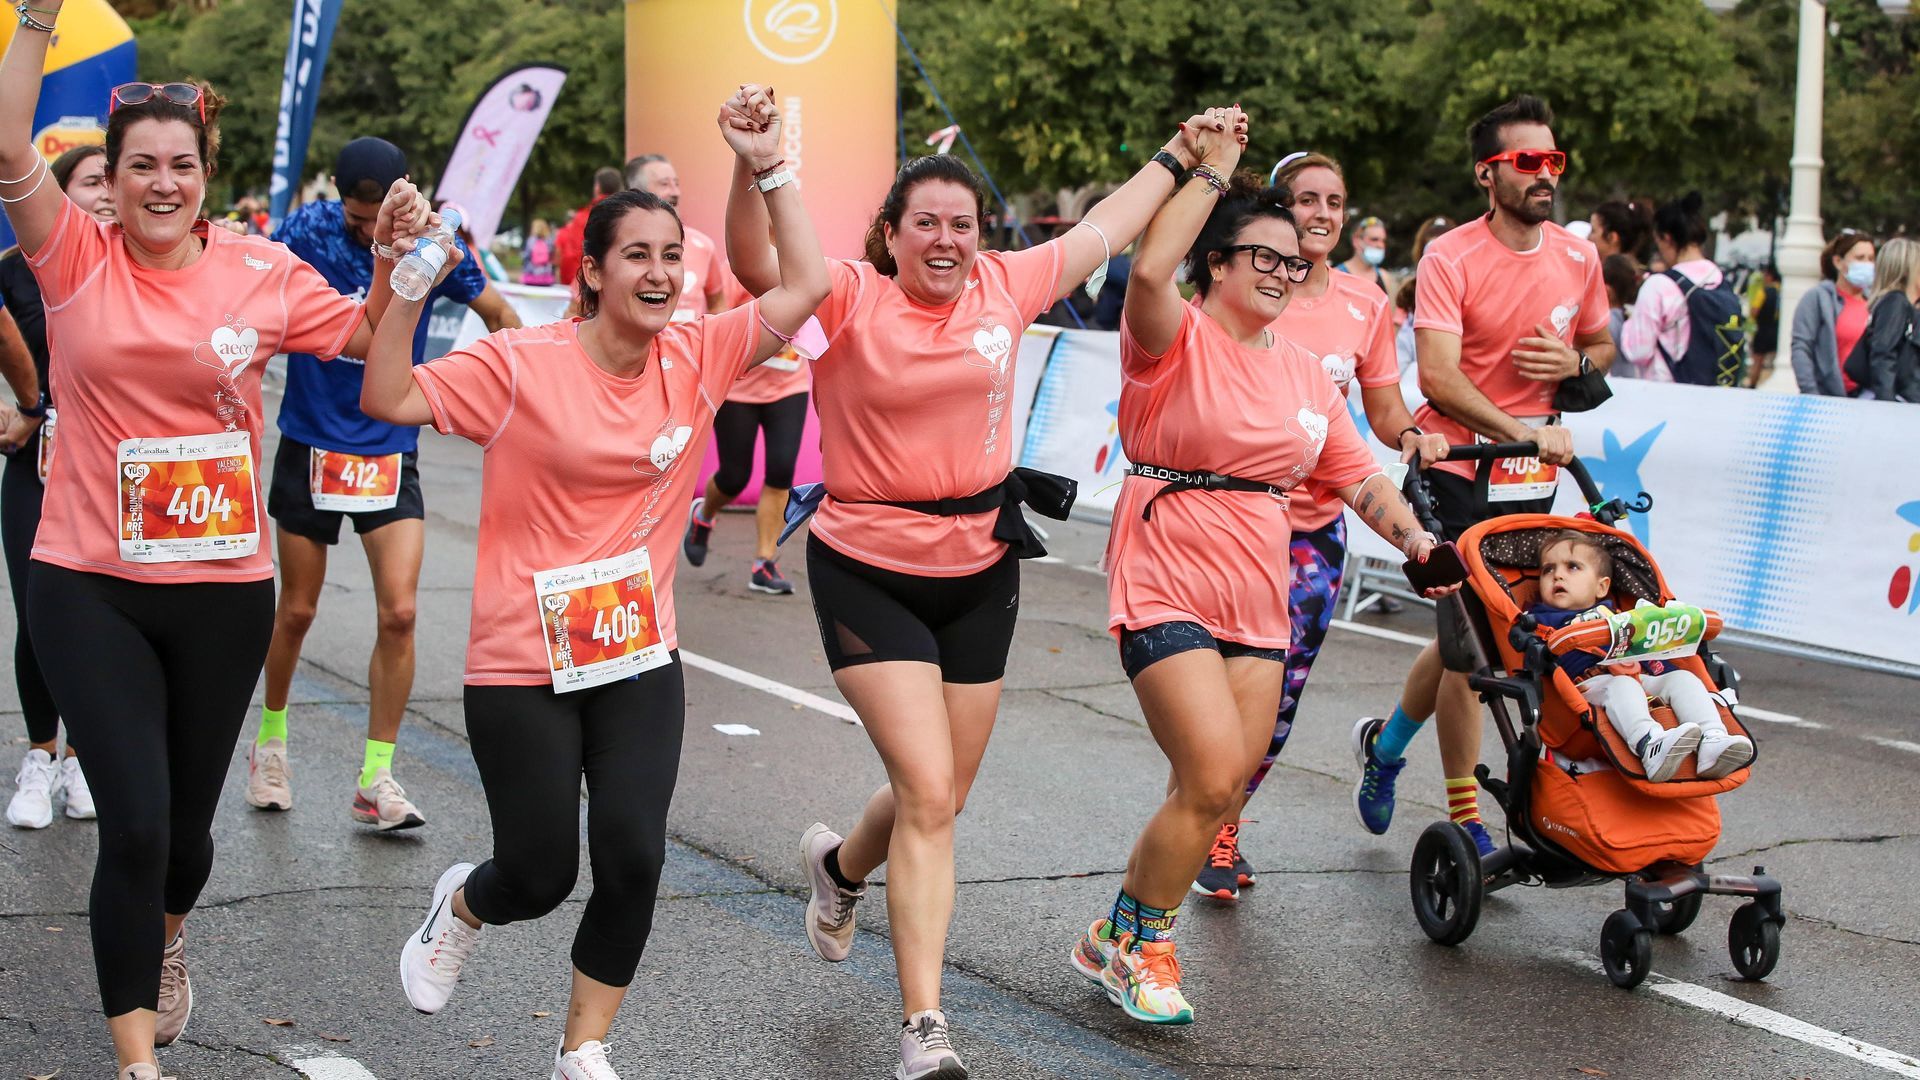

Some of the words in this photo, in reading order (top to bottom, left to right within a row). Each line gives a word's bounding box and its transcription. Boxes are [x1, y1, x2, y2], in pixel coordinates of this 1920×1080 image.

[783, 96, 802, 190] UCCINI
[219, 342, 253, 356] aecc
[982, 337, 1010, 356] aecc
[1305, 420, 1327, 442] aec
[186, 446, 208, 454] aecc
[656, 442, 684, 464] aec
[1501, 456, 1541, 475] 409
[340, 461, 379, 489] 412
[166, 484, 231, 525] 404
[131, 512, 143, 522] CA
[126, 522, 144, 532] RRE
[131, 532, 144, 541] RA
[592, 600, 641, 647] 406
[1643, 614, 1692, 649] 959
[559, 641, 571, 651] CA
[556, 650, 573, 662] RRE
[562, 659, 574, 670] RA
[1141, 916, 1172, 929] COOL!
